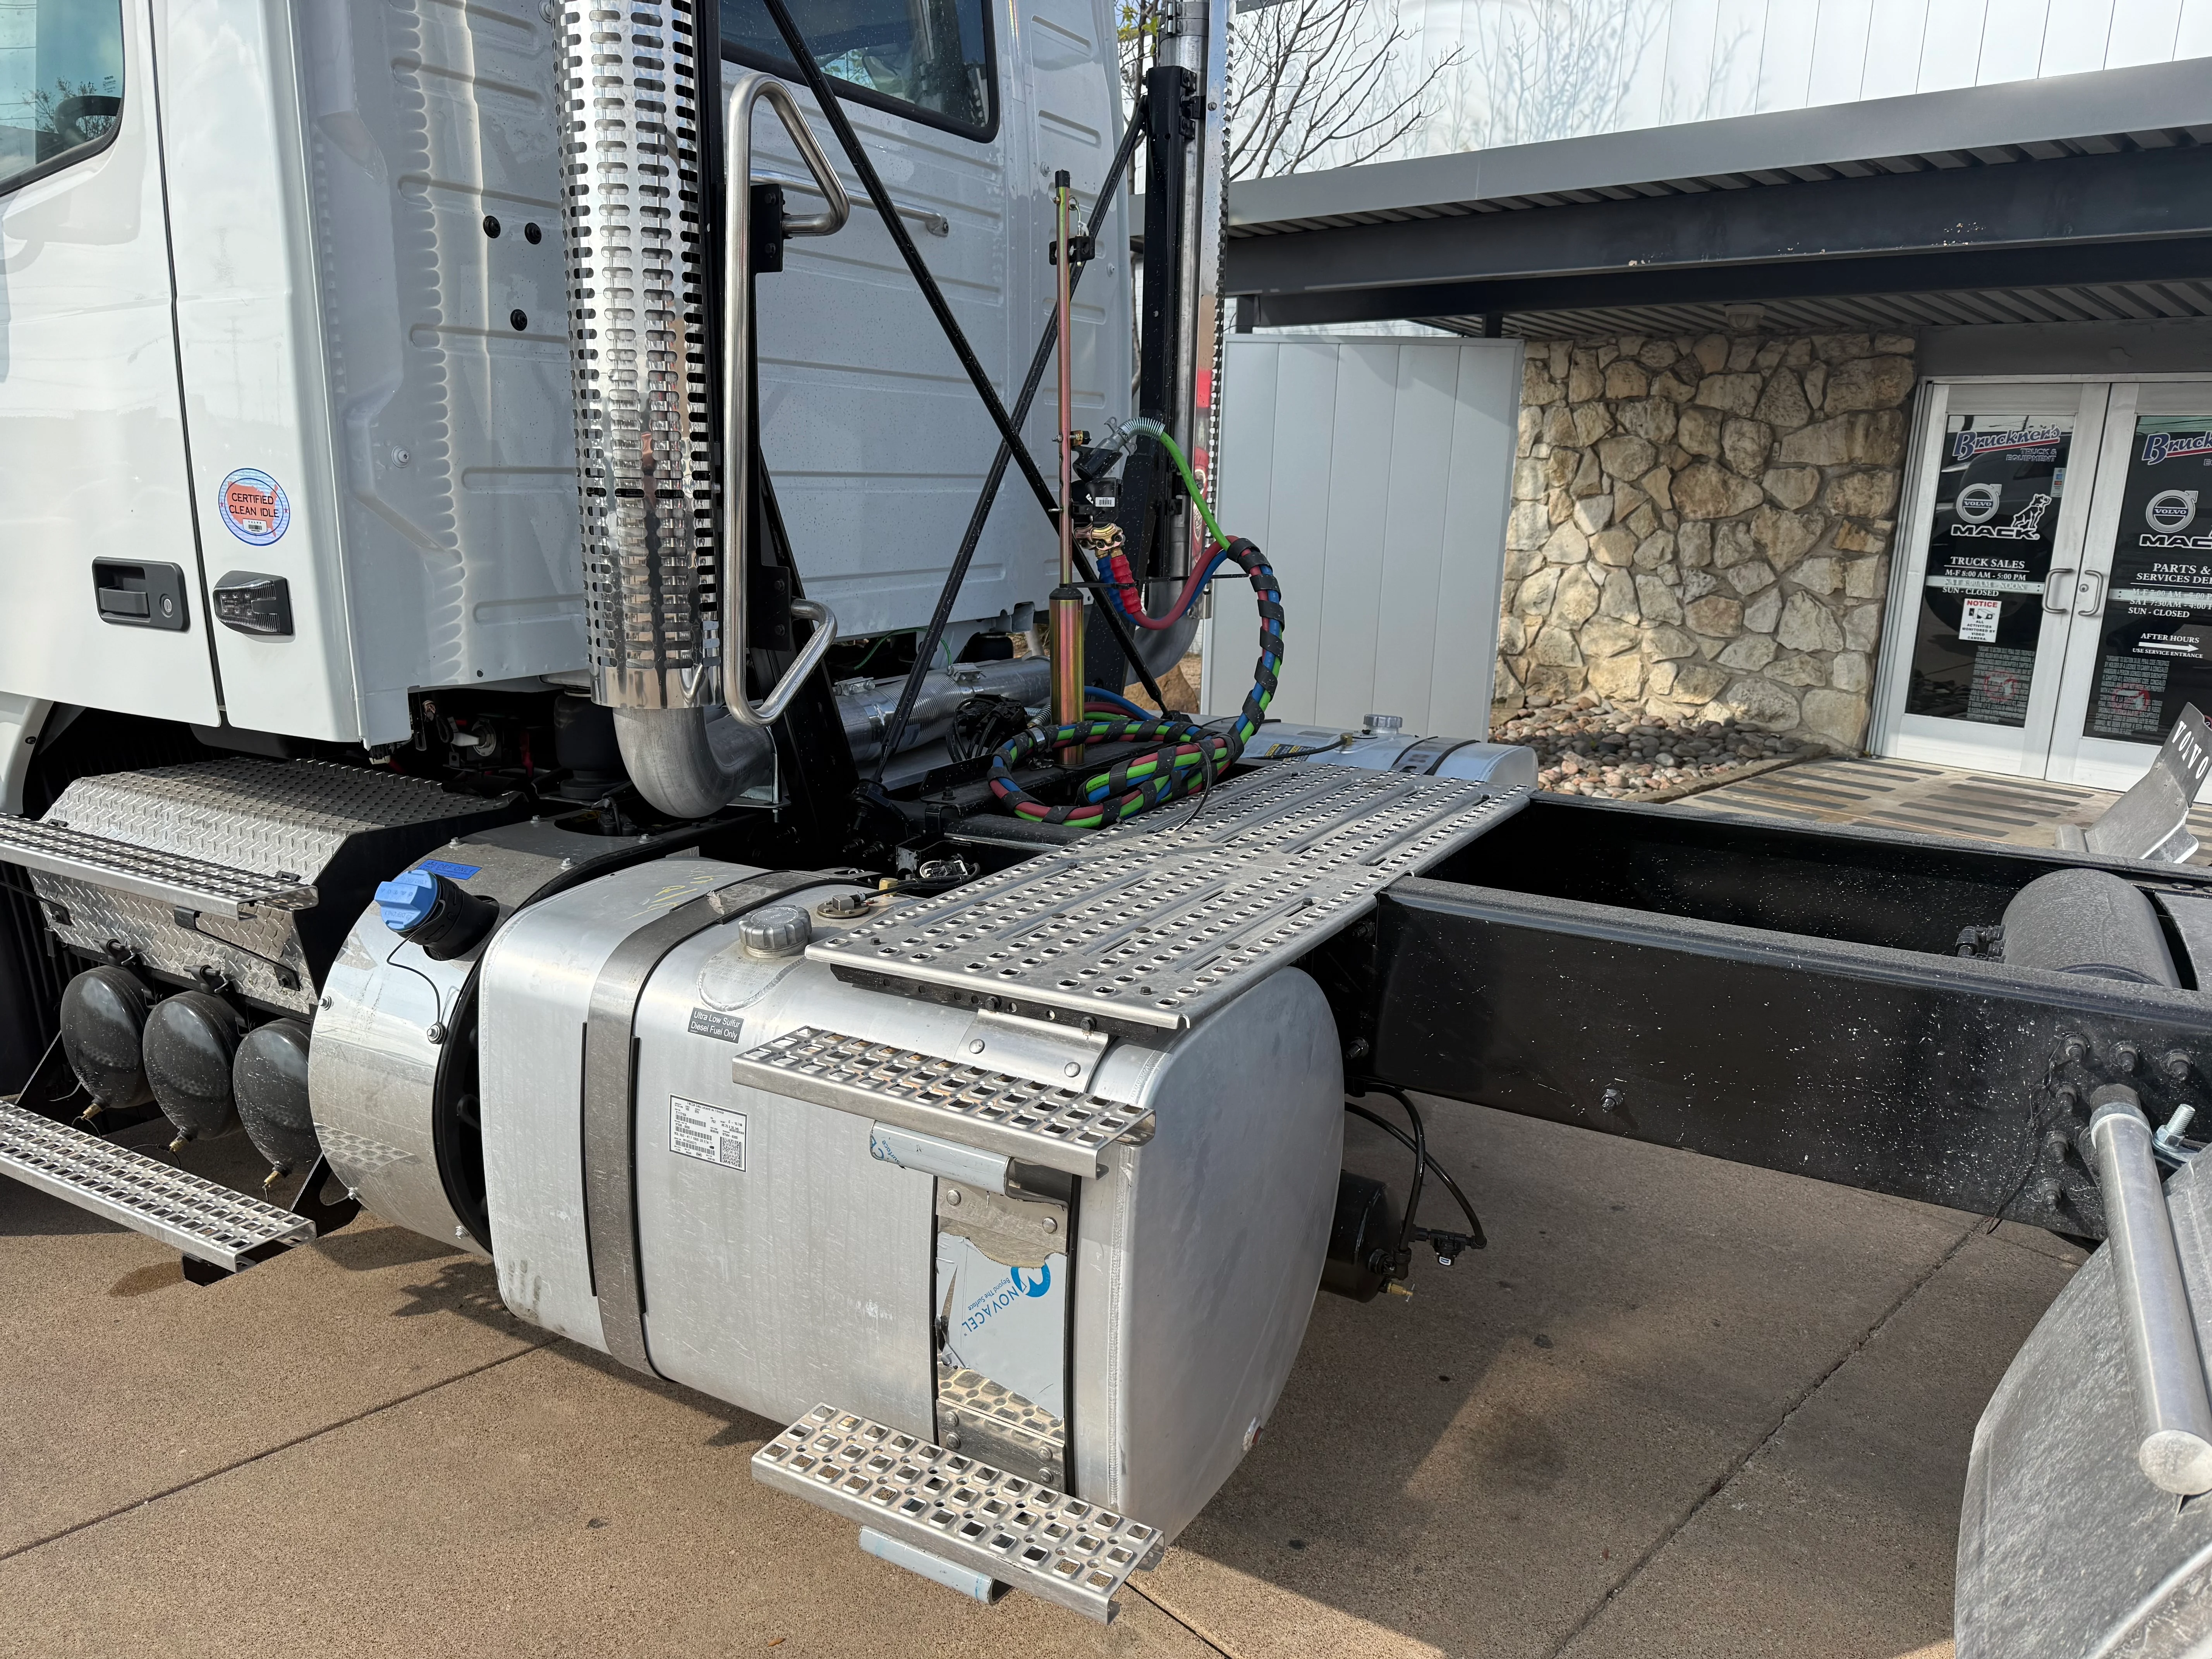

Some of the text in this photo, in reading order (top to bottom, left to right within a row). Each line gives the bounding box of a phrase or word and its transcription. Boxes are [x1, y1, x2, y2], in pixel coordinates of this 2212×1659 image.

[1953, 423, 2061, 460] Bruckner's
[232, 493, 274, 505] CERTIFIED
[229, 505, 280, 518] CLEAN IDLE
[1951, 524, 2037, 540] MACK
[2139, 534, 2212, 550] MAC
[1950, 556, 2025, 569] TRUCK SALES
[2152, 563, 2211, 575] PARTS &
[2136, 573, 2190, 583] SERVICES
[1965, 588, 1999, 597] CLOSED
[1998, 582, 2025, 590] NOON
[2153, 609, 2190, 618] CLOSED
[2172, 720, 2209, 779] VOLVO
[694, 1010, 740, 1028] Ultra Low Sulfur
[691, 1021, 738, 1041] Diesel Fuel Only
[968, 1278, 1011, 1310] Beyond The Surface
[962, 1286, 1020, 1332] NOVACEL
